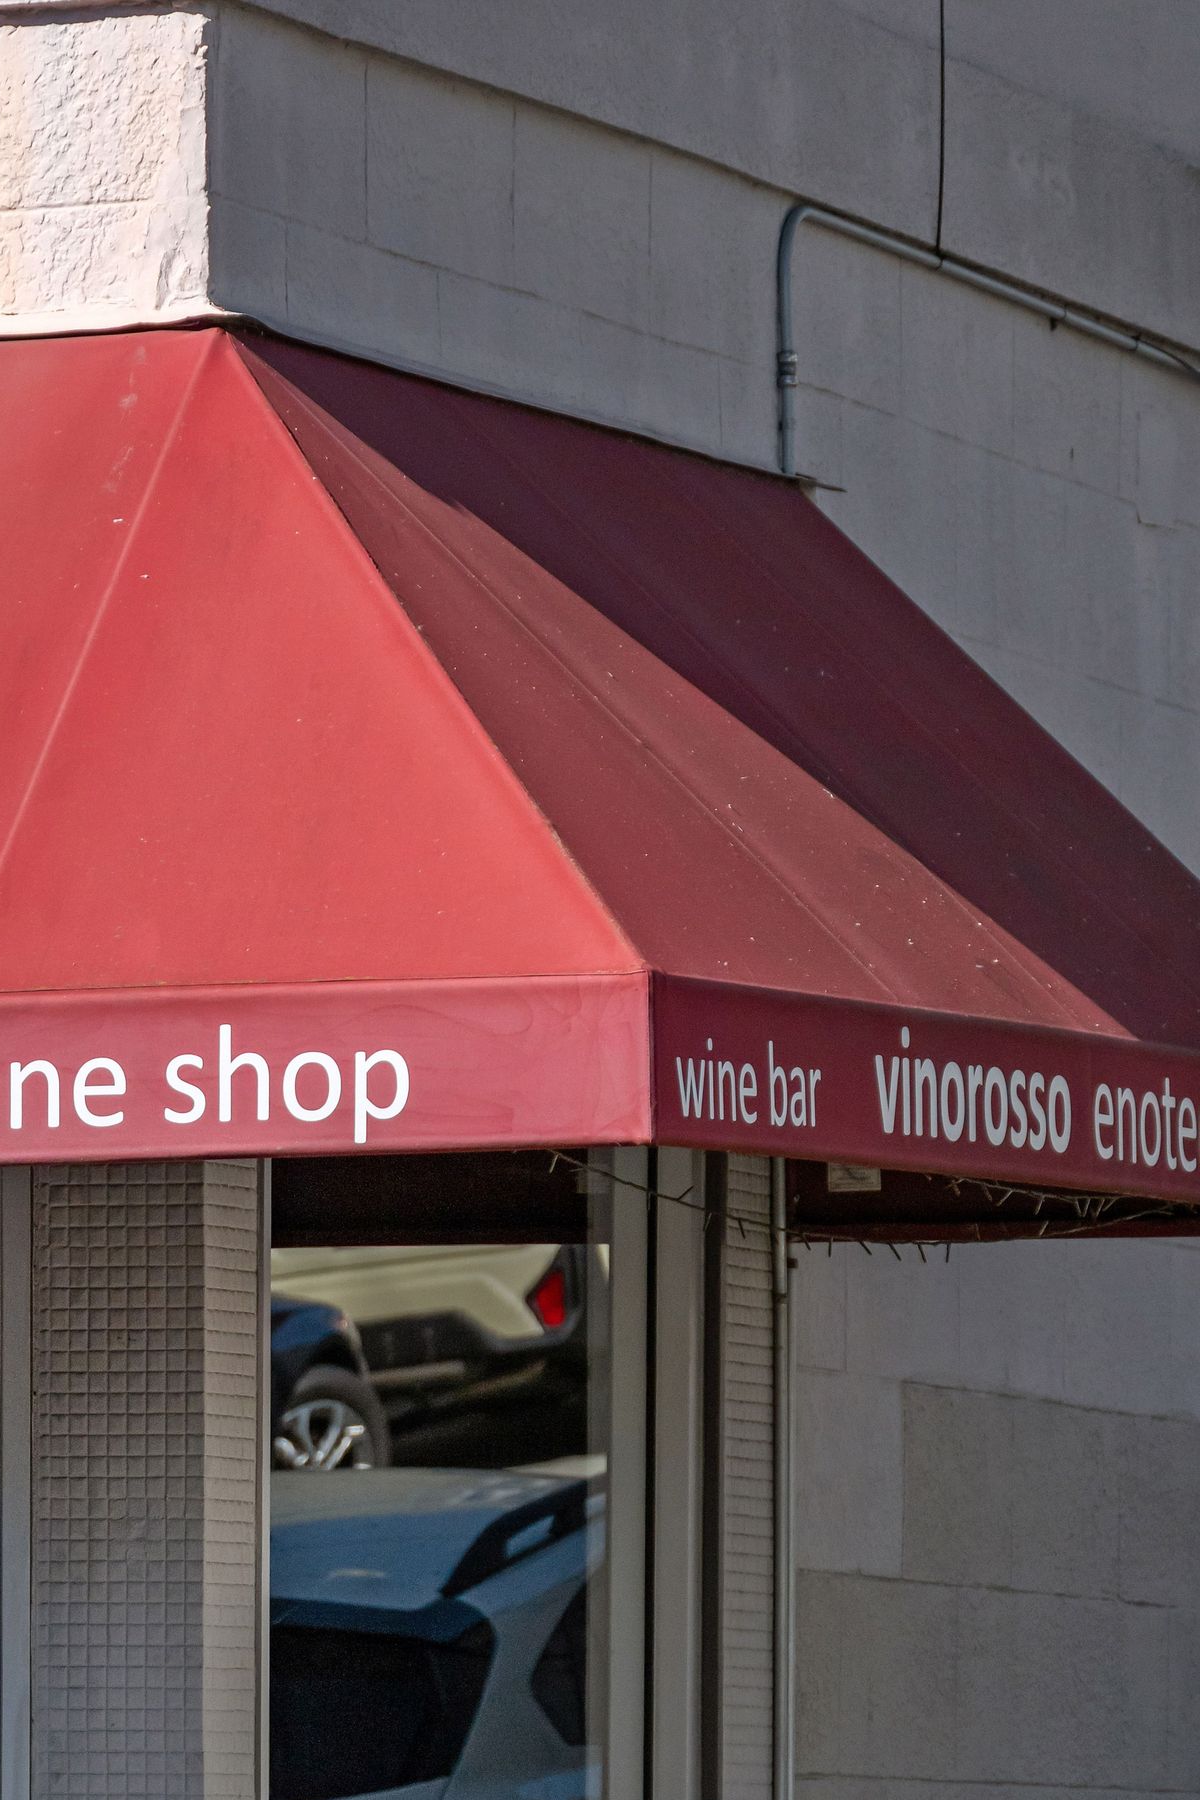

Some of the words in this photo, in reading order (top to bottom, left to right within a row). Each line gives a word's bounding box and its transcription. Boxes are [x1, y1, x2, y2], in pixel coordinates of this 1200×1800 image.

[163, 1023, 411, 1145] shop
[676, 1037, 758, 1124] wine
[768, 1040, 822, 1128] bar
[874, 1026, 1072, 1154] vinorosso
[1094, 1077, 1198, 1173] enote
